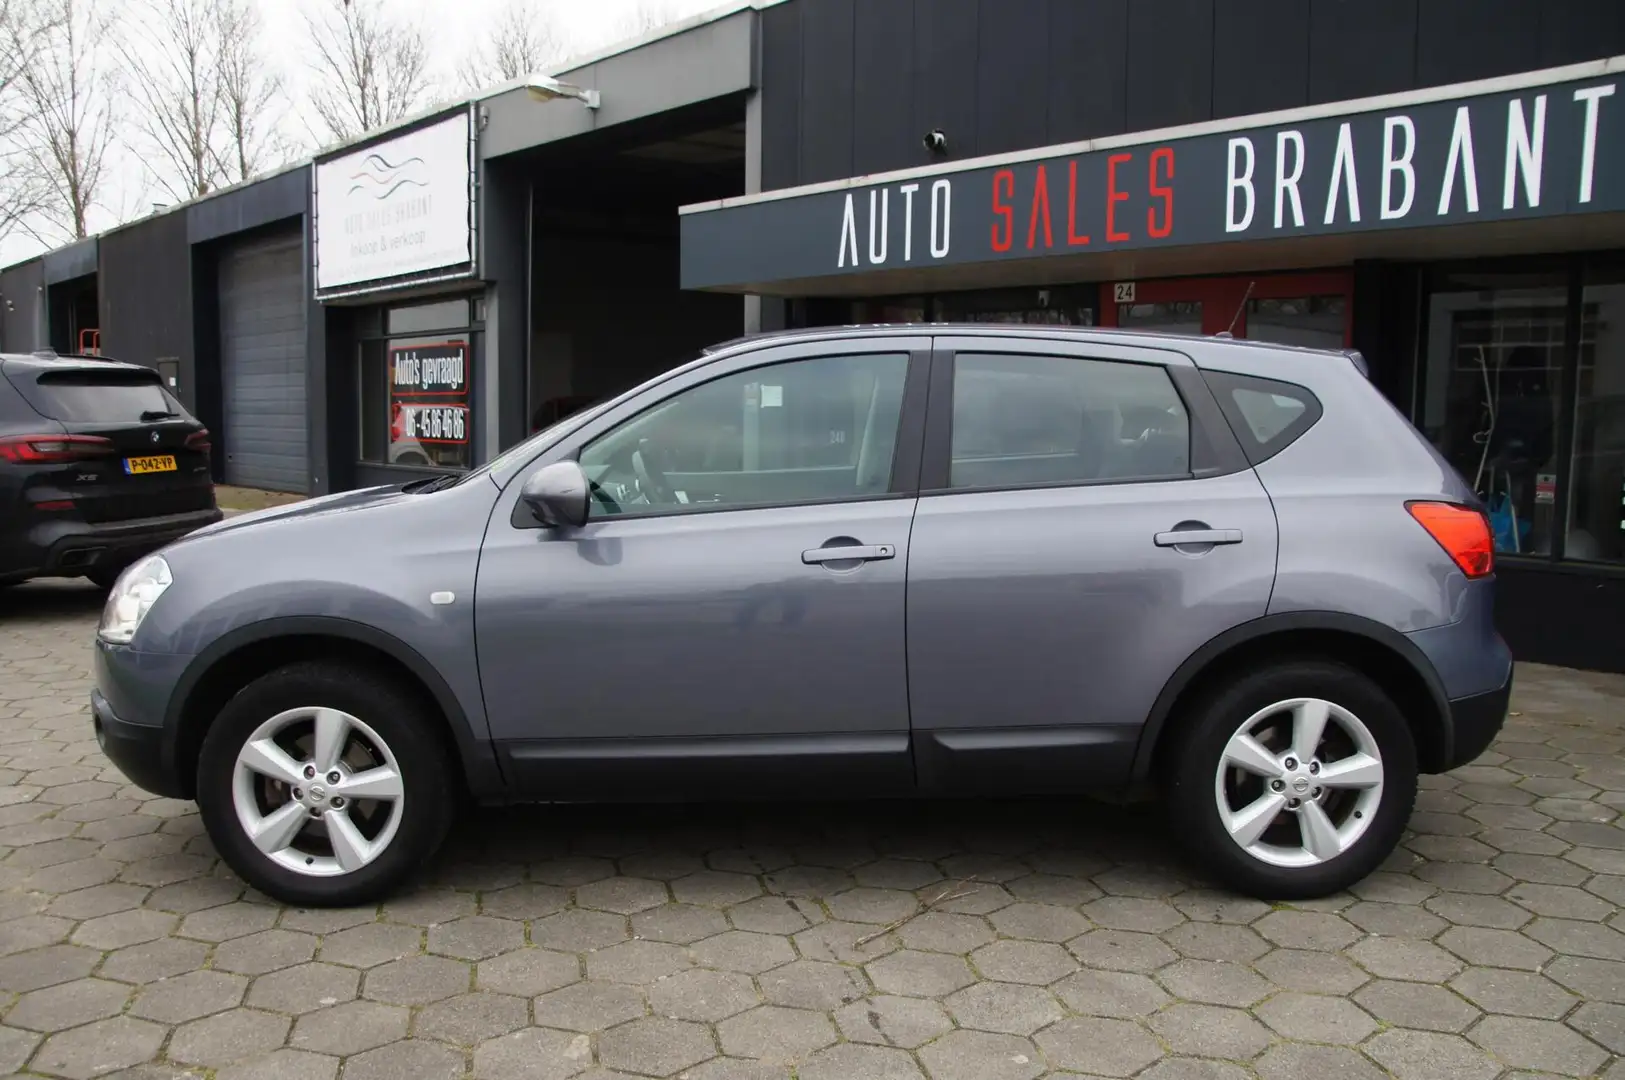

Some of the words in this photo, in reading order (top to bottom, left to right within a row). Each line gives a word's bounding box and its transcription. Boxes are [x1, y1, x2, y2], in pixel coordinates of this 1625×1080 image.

[837, 178, 951, 268] AUTO
[990, 146, 1175, 253] SALES
[1225, 84, 1616, 233] BRABANT
[1117, 284, 1132, 300] 24
[394, 351, 420, 385] Auto's
[421, 348, 464, 390] gevraagd
[131, 457, 173, 472] P-042-VP
